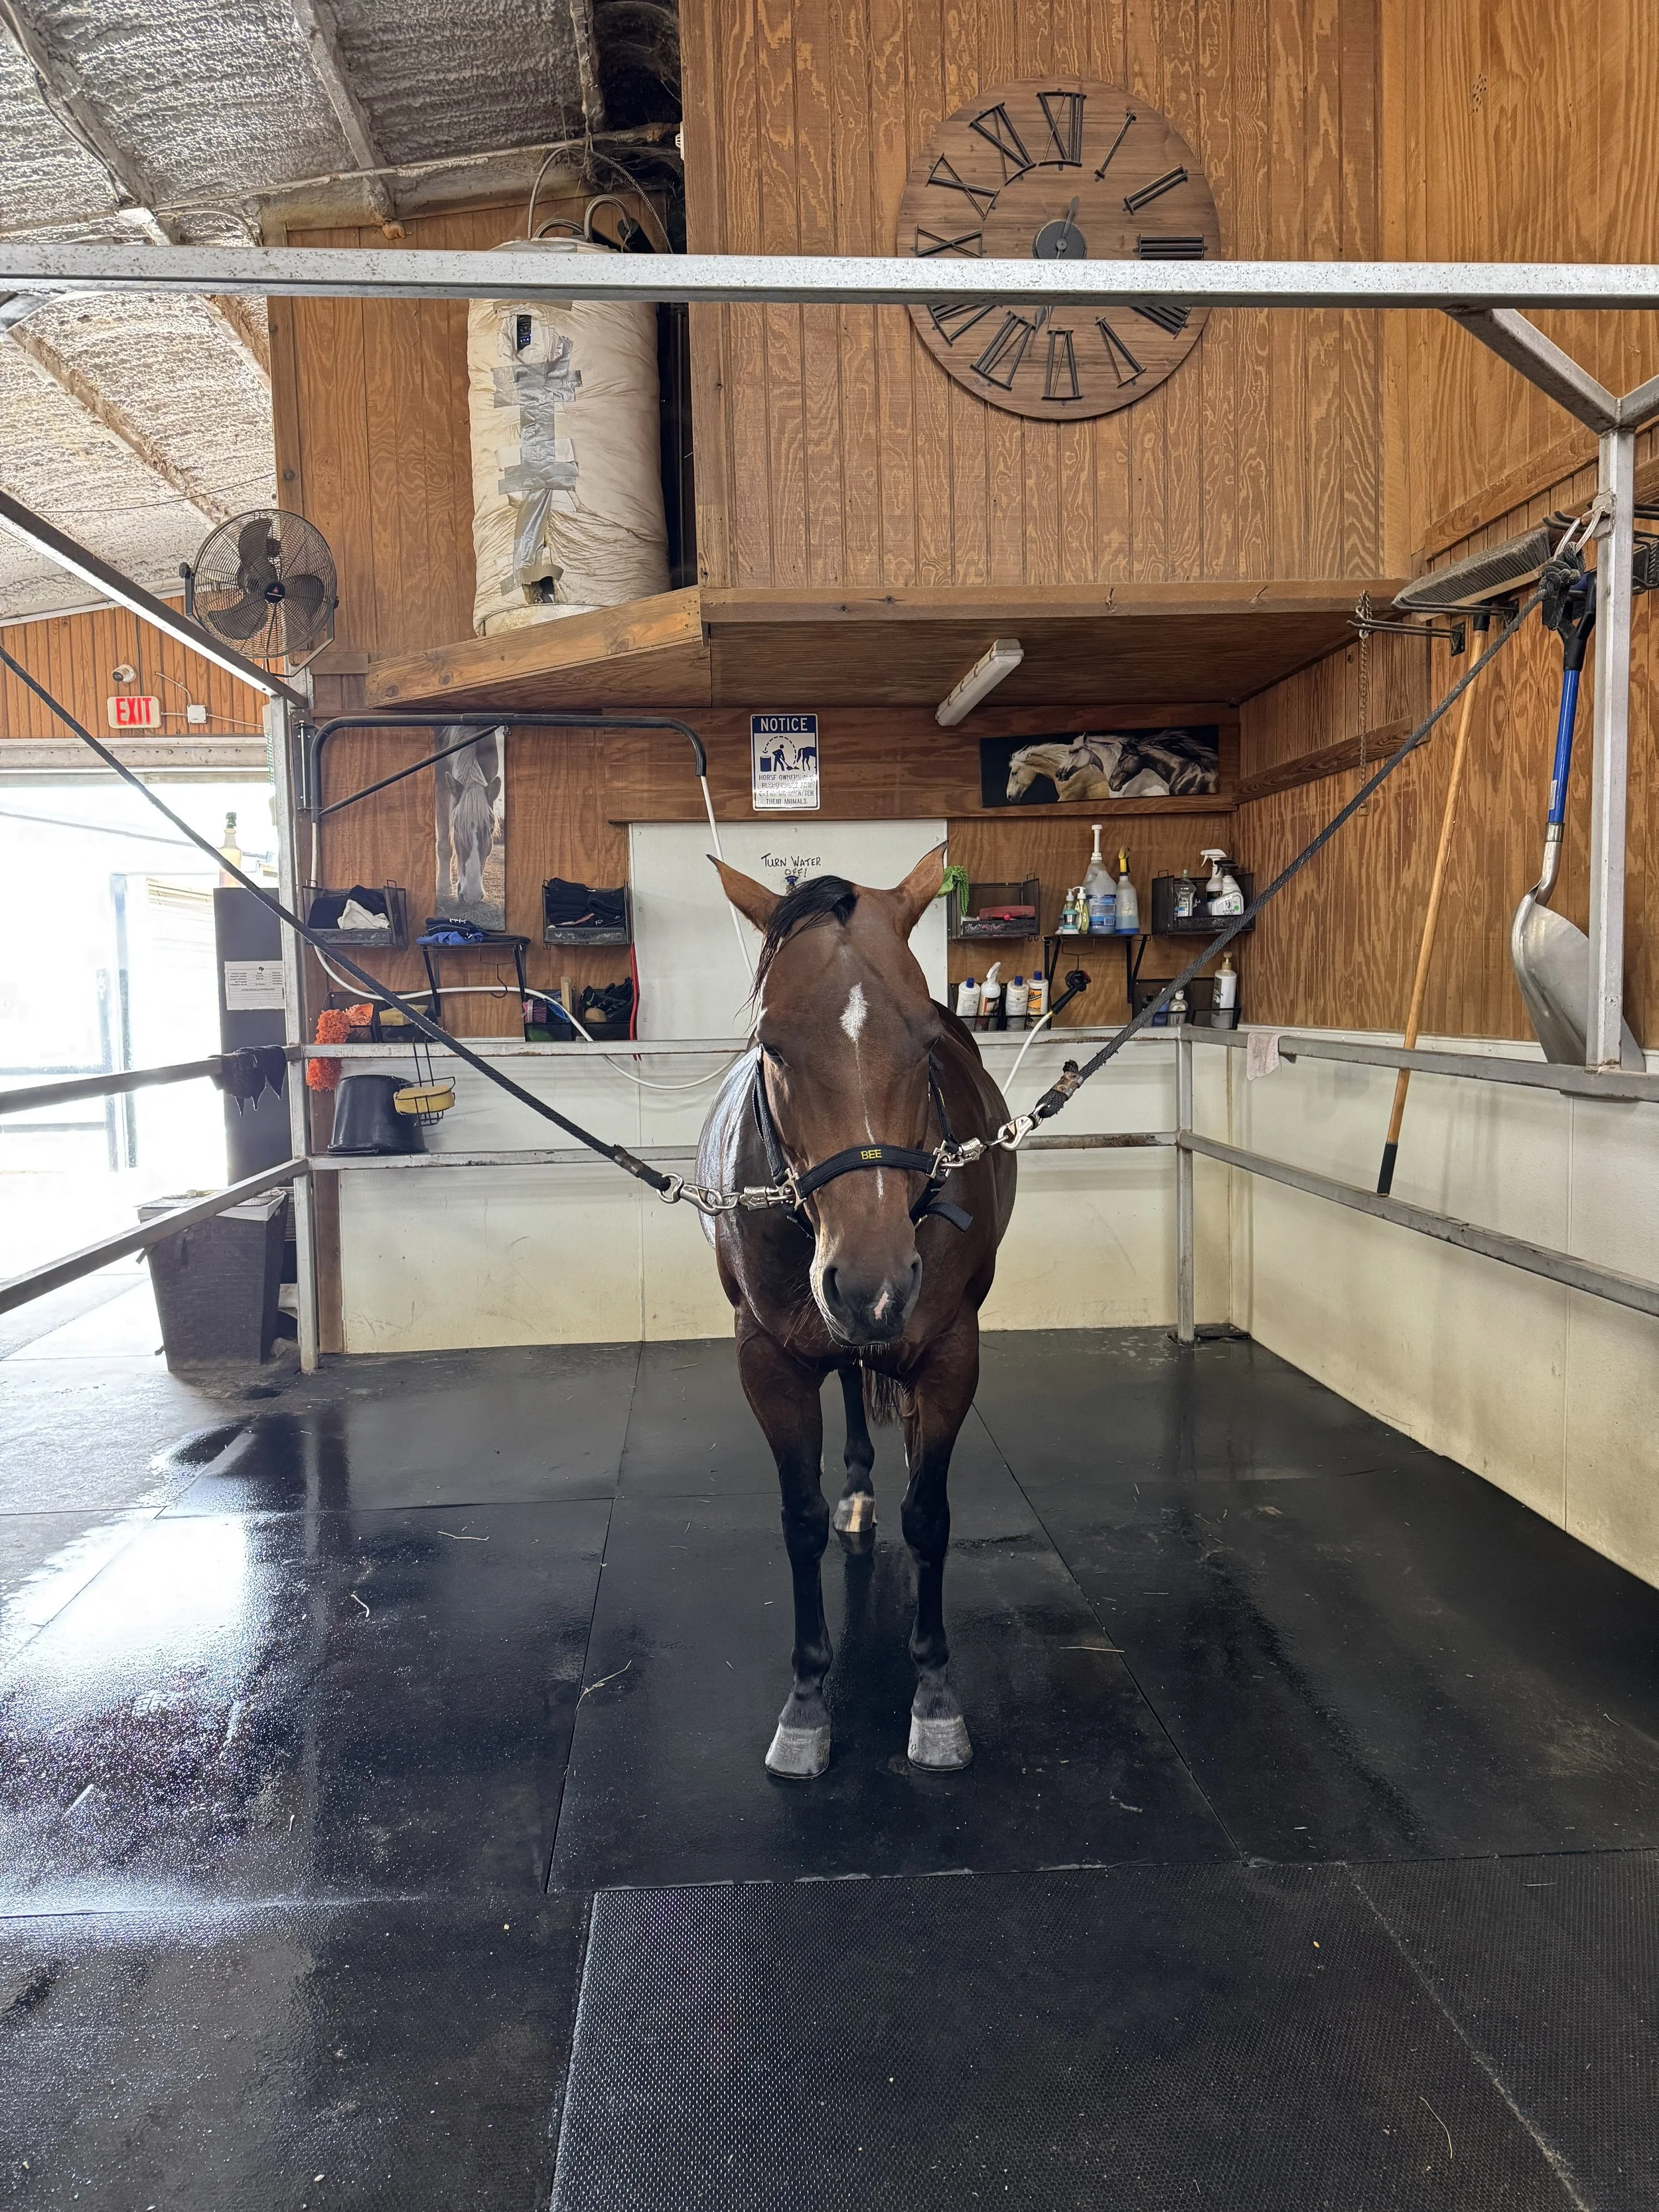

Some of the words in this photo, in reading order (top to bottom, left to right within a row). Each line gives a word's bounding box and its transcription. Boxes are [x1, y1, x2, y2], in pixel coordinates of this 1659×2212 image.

[116, 698, 151, 725] EXIT
[760, 717, 808, 731] NOTICE
[790, 855, 822, 867] WATER
[861, 1149, 883, 1160] BEE
